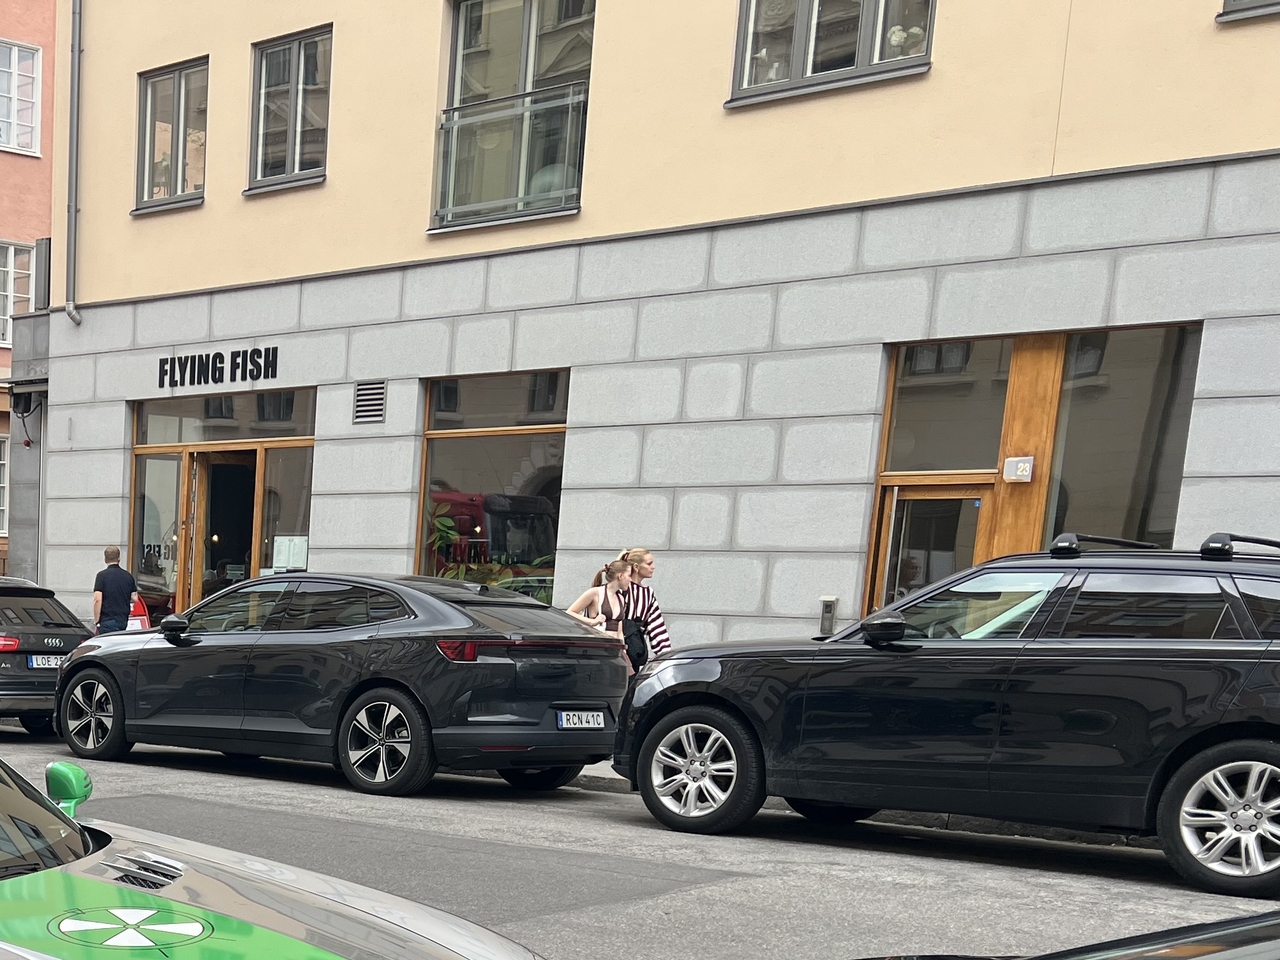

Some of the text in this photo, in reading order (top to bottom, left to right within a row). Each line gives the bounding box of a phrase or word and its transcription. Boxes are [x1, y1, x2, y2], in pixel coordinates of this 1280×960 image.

[158, 346, 279, 388] FLYING FISH
[1016, 462, 1030, 475] 23
[35, 656, 52, 667] LOE
[565, 712, 602, 727] RCN 41C
